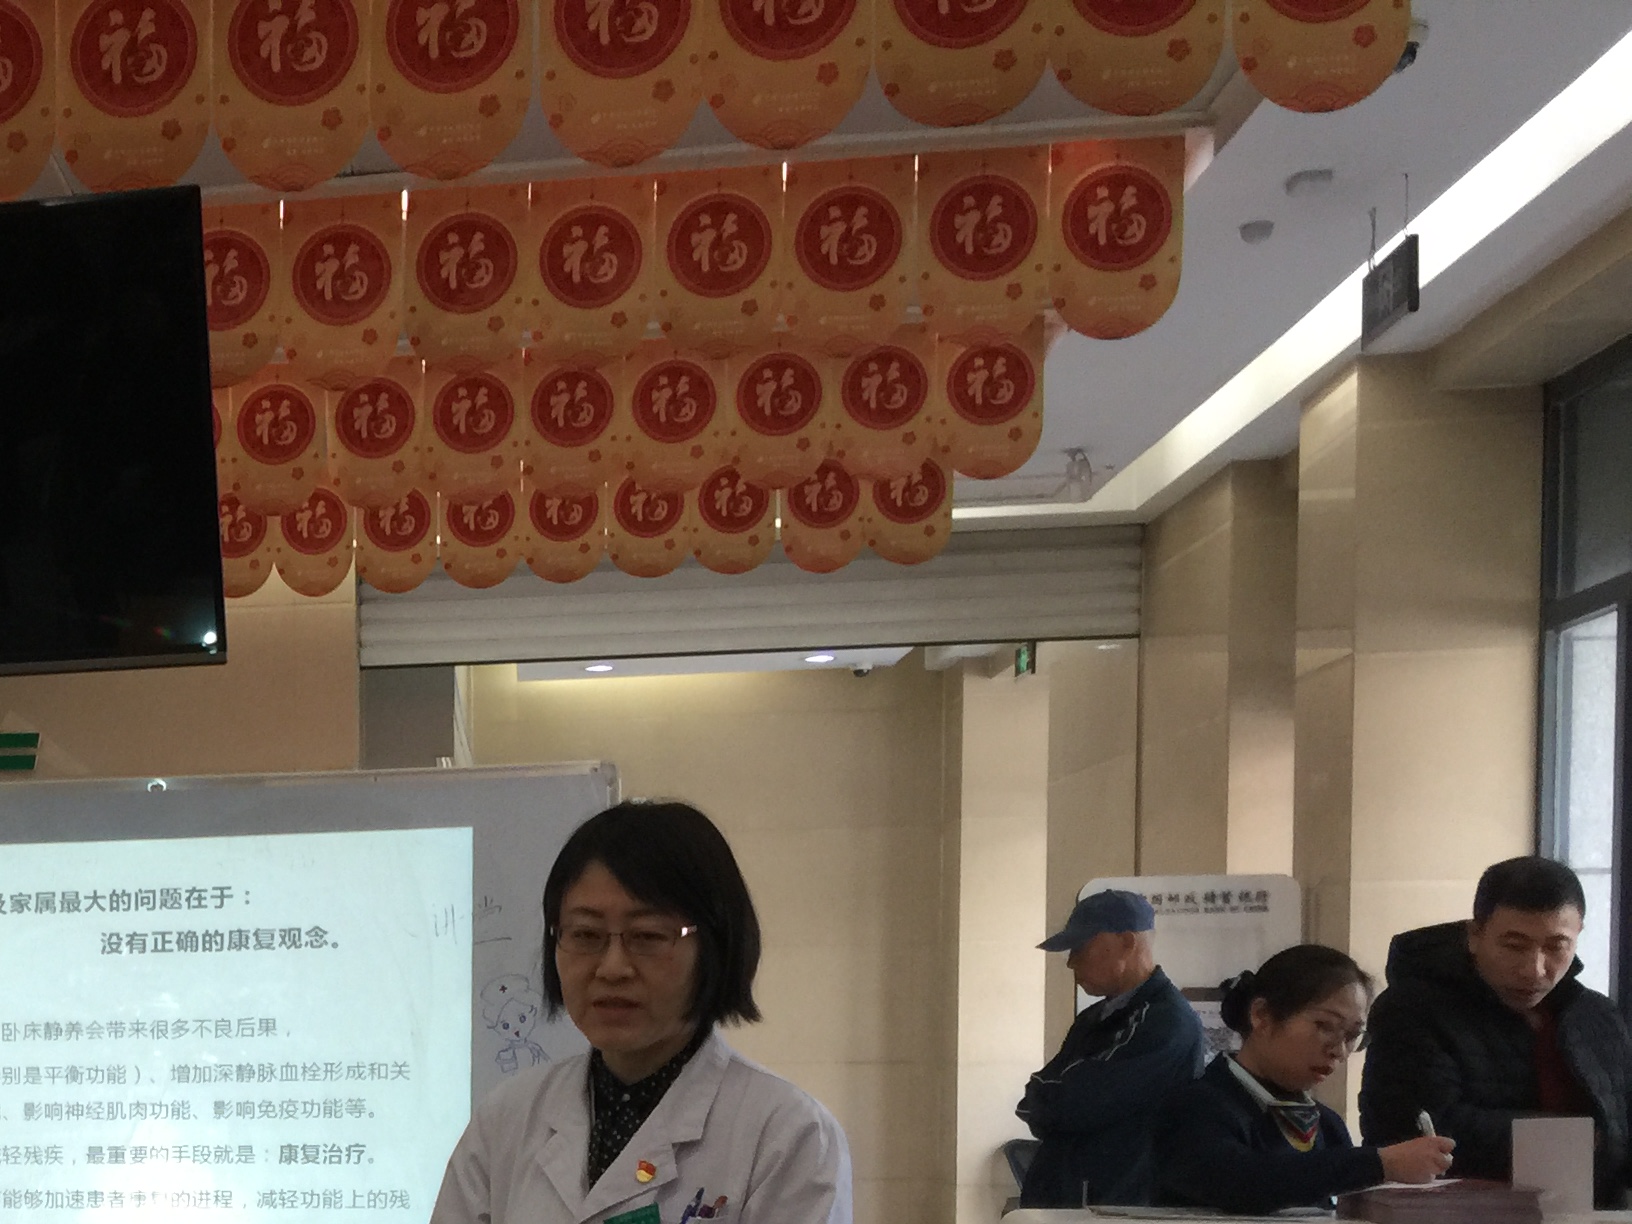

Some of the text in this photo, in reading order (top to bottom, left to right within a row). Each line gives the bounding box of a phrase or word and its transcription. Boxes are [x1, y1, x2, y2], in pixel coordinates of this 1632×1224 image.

[99, 9, 167, 85] 福
[258, 0, 328, 73] 福
[416, 0, 487, 61] 福
[820, 205, 877, 266] 福
[954, 195, 1012, 255] 福
[1088, 184, 1147, 247] 福
[438, 231, 494, 290] 福
[563, 224, 618, 285] 福
[690, 213, 748, 273] 福
[315, 243, 368, 301] 福
[550, 380, 594, 428] 福
[652, 376, 696, 423] 福
[756, 368, 801, 415] 福
[861, 361, 907, 409] 福
[967, 356, 1015, 406] 福
[255, 399, 297, 446] 福
[353, 392, 396, 439] 福
[451, 386, 495, 435] 福
[378, 496, 415, 535] 福
[714, 476, 753, 517] 福
[804, 471, 844, 512] 福
[296, 499, 332, 539] 福
[100, 925, 342, 956] 没有正确的康复观念。
